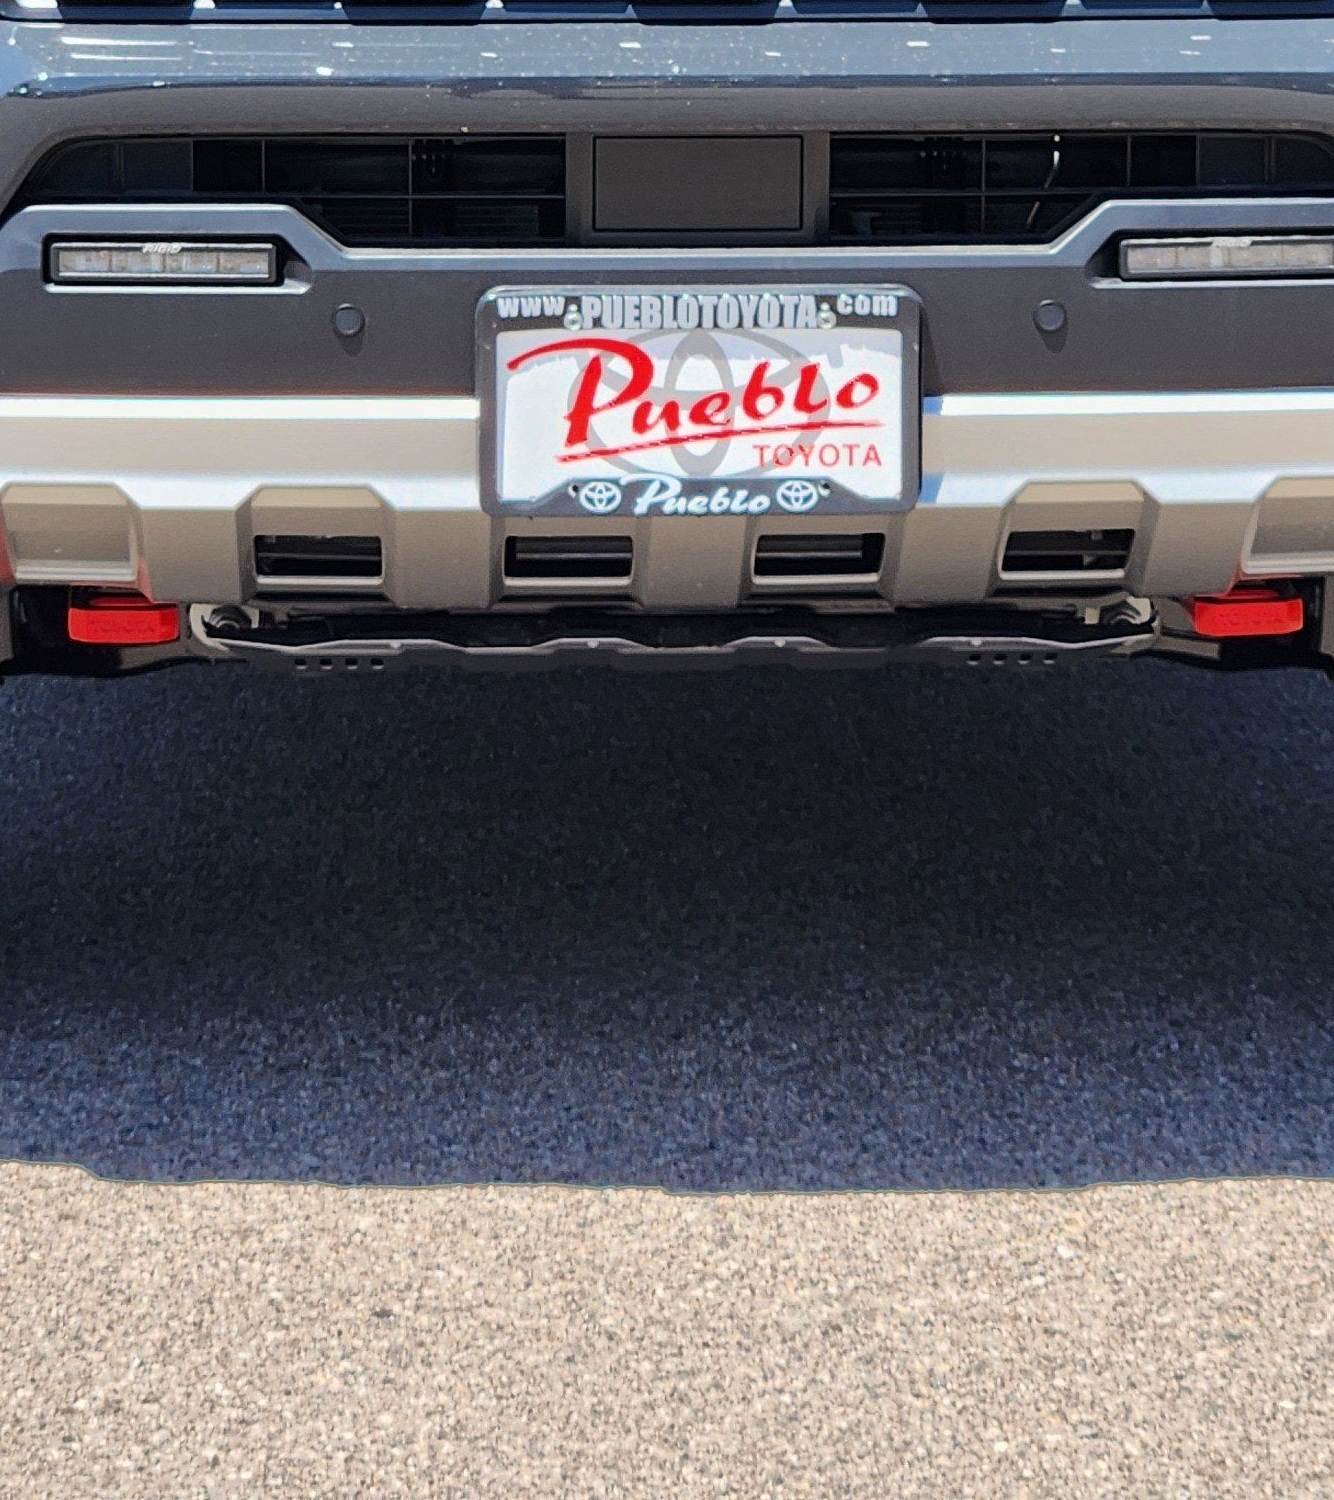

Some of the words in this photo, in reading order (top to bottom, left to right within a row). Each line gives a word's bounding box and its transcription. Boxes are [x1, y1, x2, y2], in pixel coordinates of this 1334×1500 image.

[507, 338, 880, 447] Pueblo
[754, 444, 882, 467] TOYOTA
[619, 473, 771, 516] Pueblo
